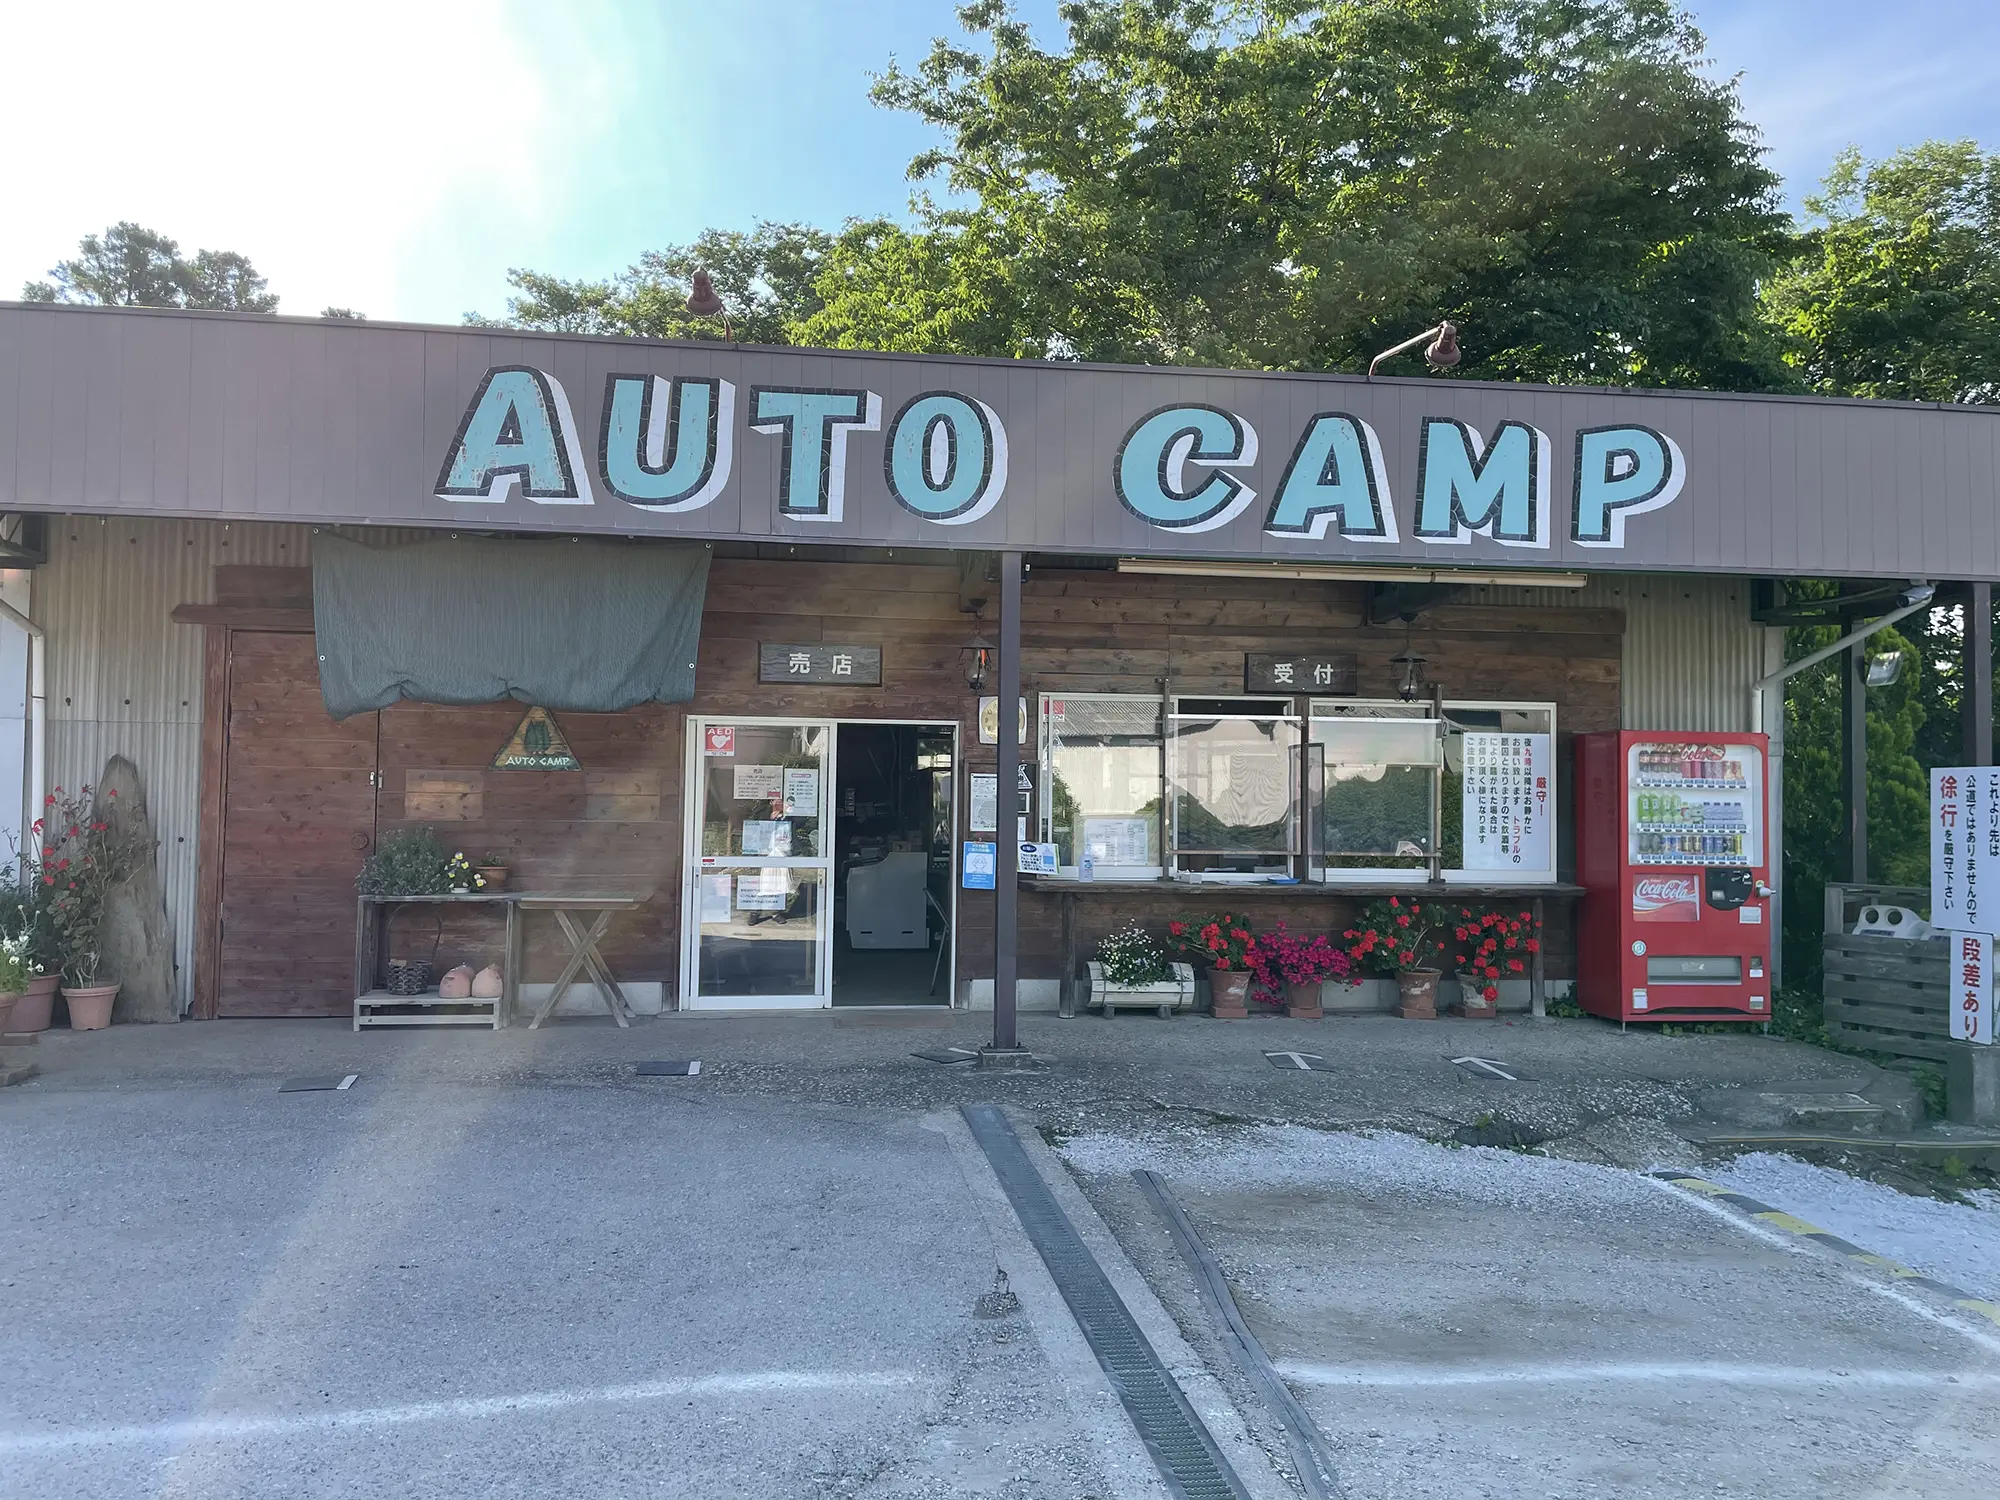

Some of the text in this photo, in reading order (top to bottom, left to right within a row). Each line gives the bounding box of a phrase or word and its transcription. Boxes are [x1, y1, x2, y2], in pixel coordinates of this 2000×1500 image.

[433, 364, 1687, 549] AUTO CAMP
[505, 756, 570, 766] AUTO CAMP
[1989, 774, 2000, 857] これより先は
[1940, 775, 1957, 910] 徐行を厳守下さい
[1965, 775, 1977, 925] 公道ではありませんので
[1962, 937, 1981, 1038] 段差あり
